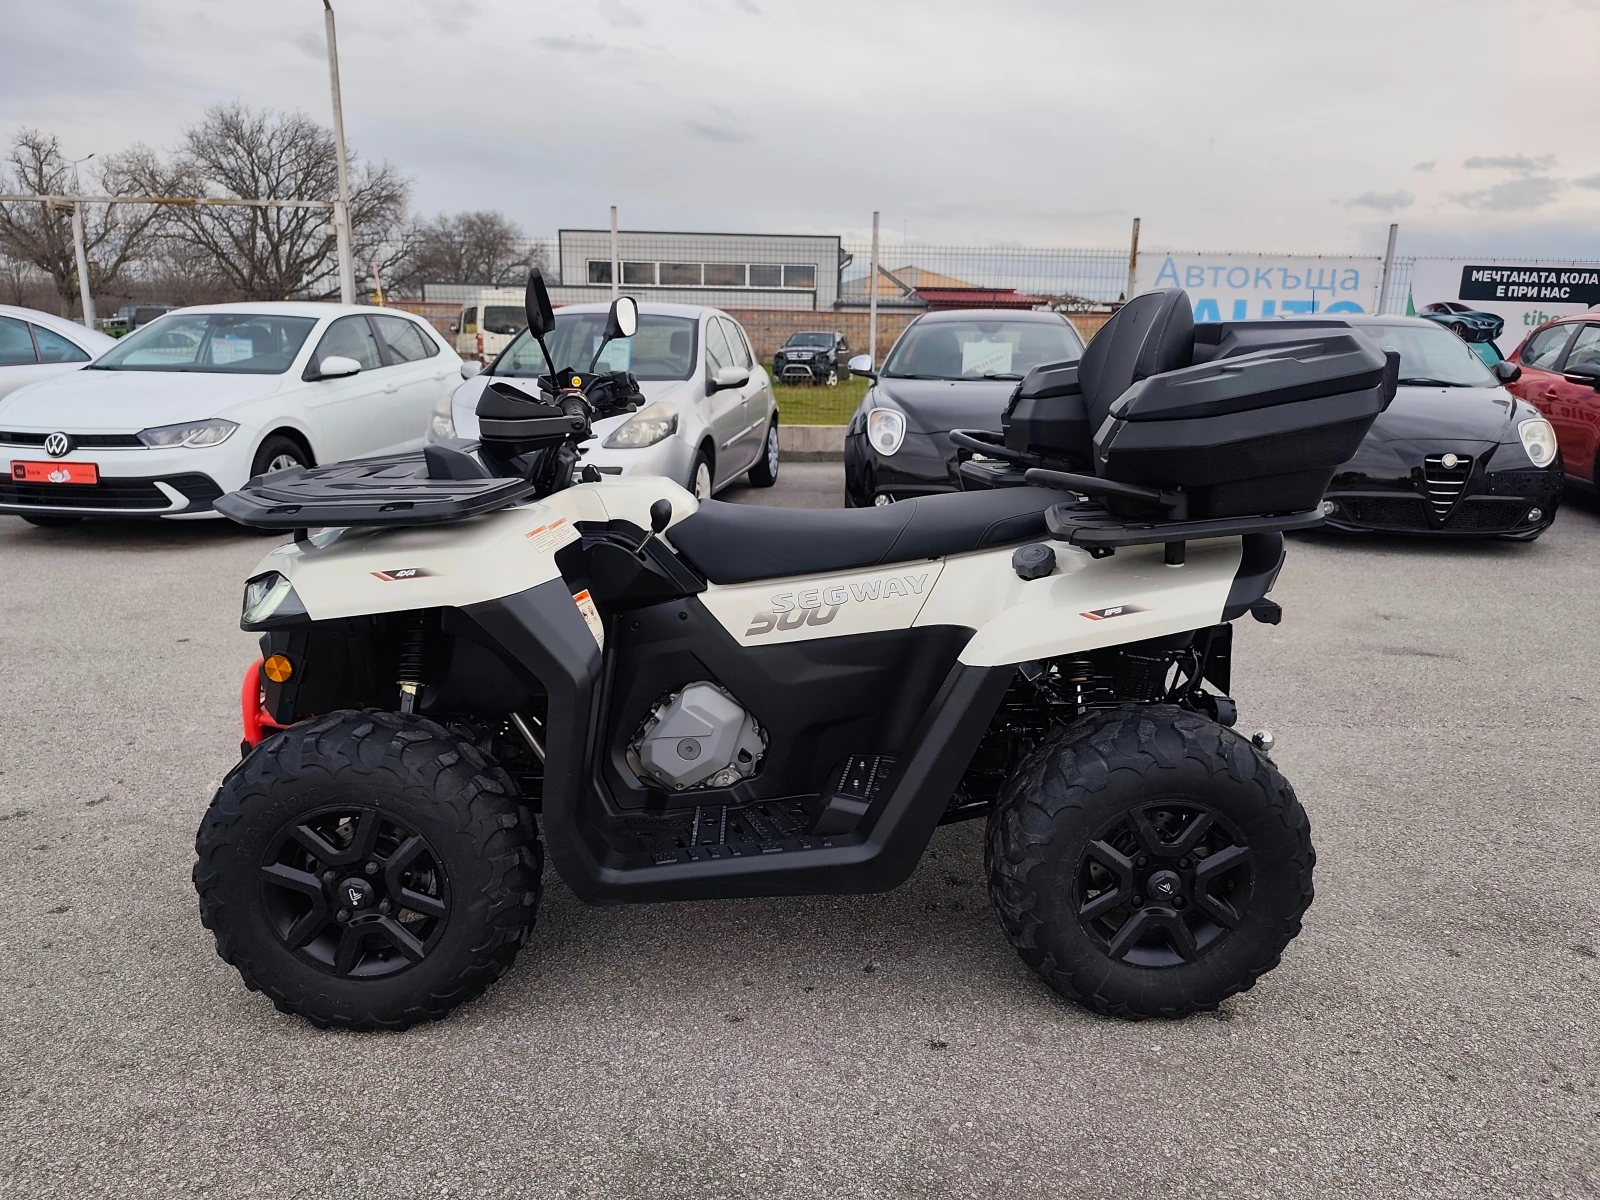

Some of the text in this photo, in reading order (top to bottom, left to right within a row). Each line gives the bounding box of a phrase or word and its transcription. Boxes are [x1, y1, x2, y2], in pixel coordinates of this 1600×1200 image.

[1153, 257, 1361, 296] Автокъща
[1471, 270, 1599, 285] МЕЧТАНАТА КОЛА
[1496, 285, 1571, 298] Е ПРИ НАС
[770, 573, 929, 614] SEGWAY
